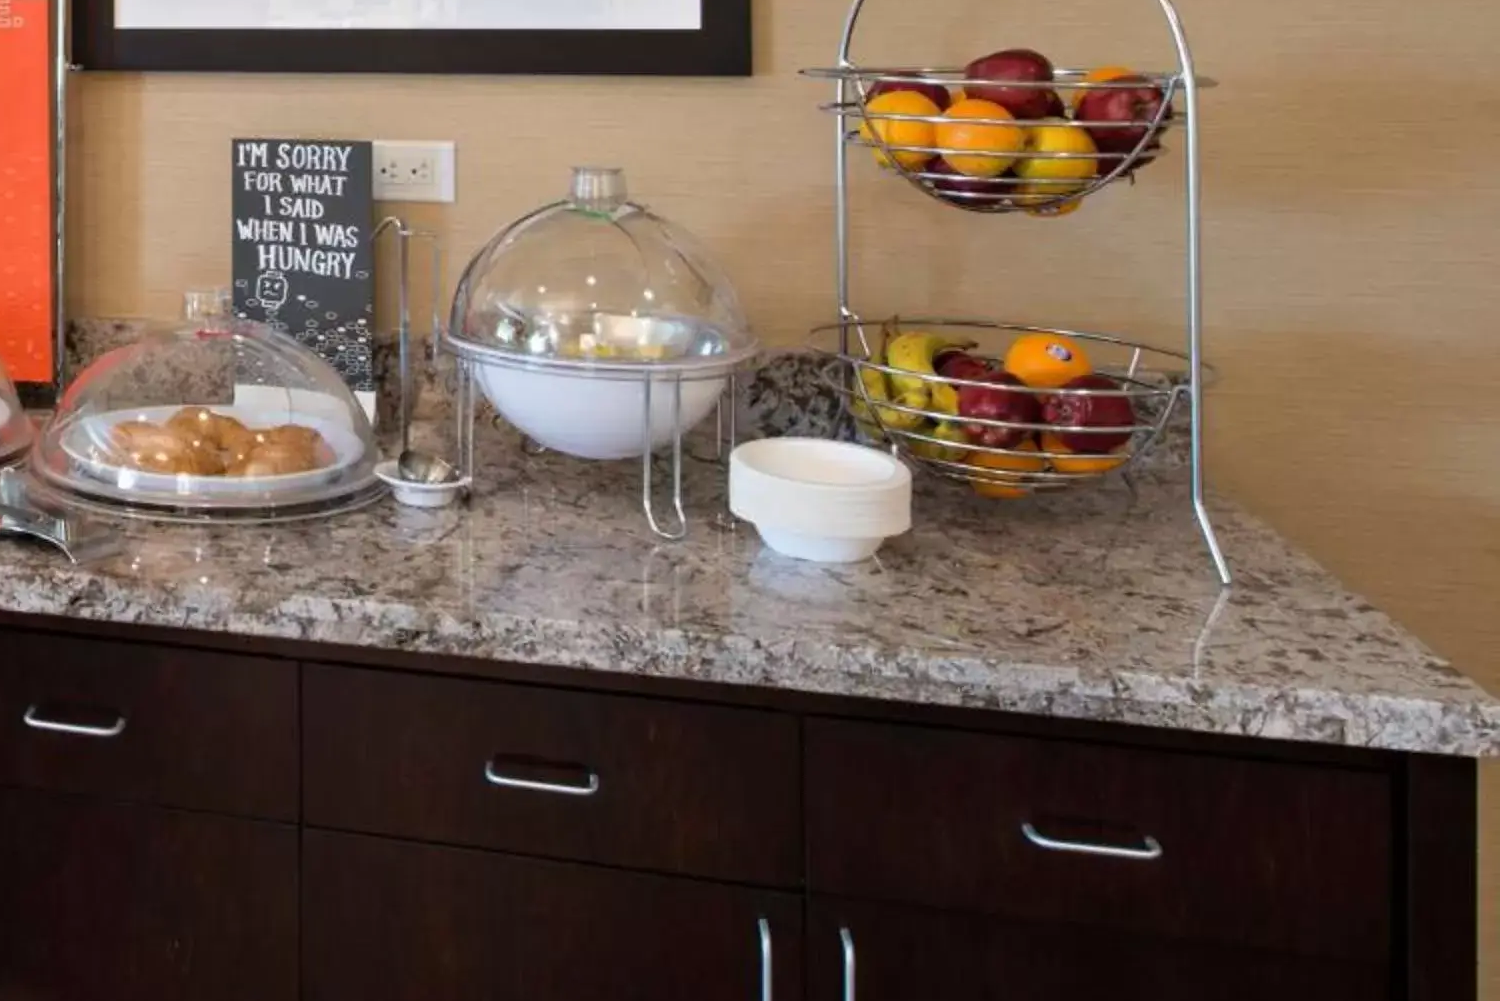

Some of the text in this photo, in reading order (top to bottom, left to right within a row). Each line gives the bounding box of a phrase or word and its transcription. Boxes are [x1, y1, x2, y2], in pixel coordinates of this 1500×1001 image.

[237, 143, 352, 171] I'M SORRY
[244, 171, 348, 196] FOR WHAT
[264, 195, 324, 218] I SAID
[236, 218, 359, 248] WHEN I WAS
[257, 245, 356, 279] HUNGRY
